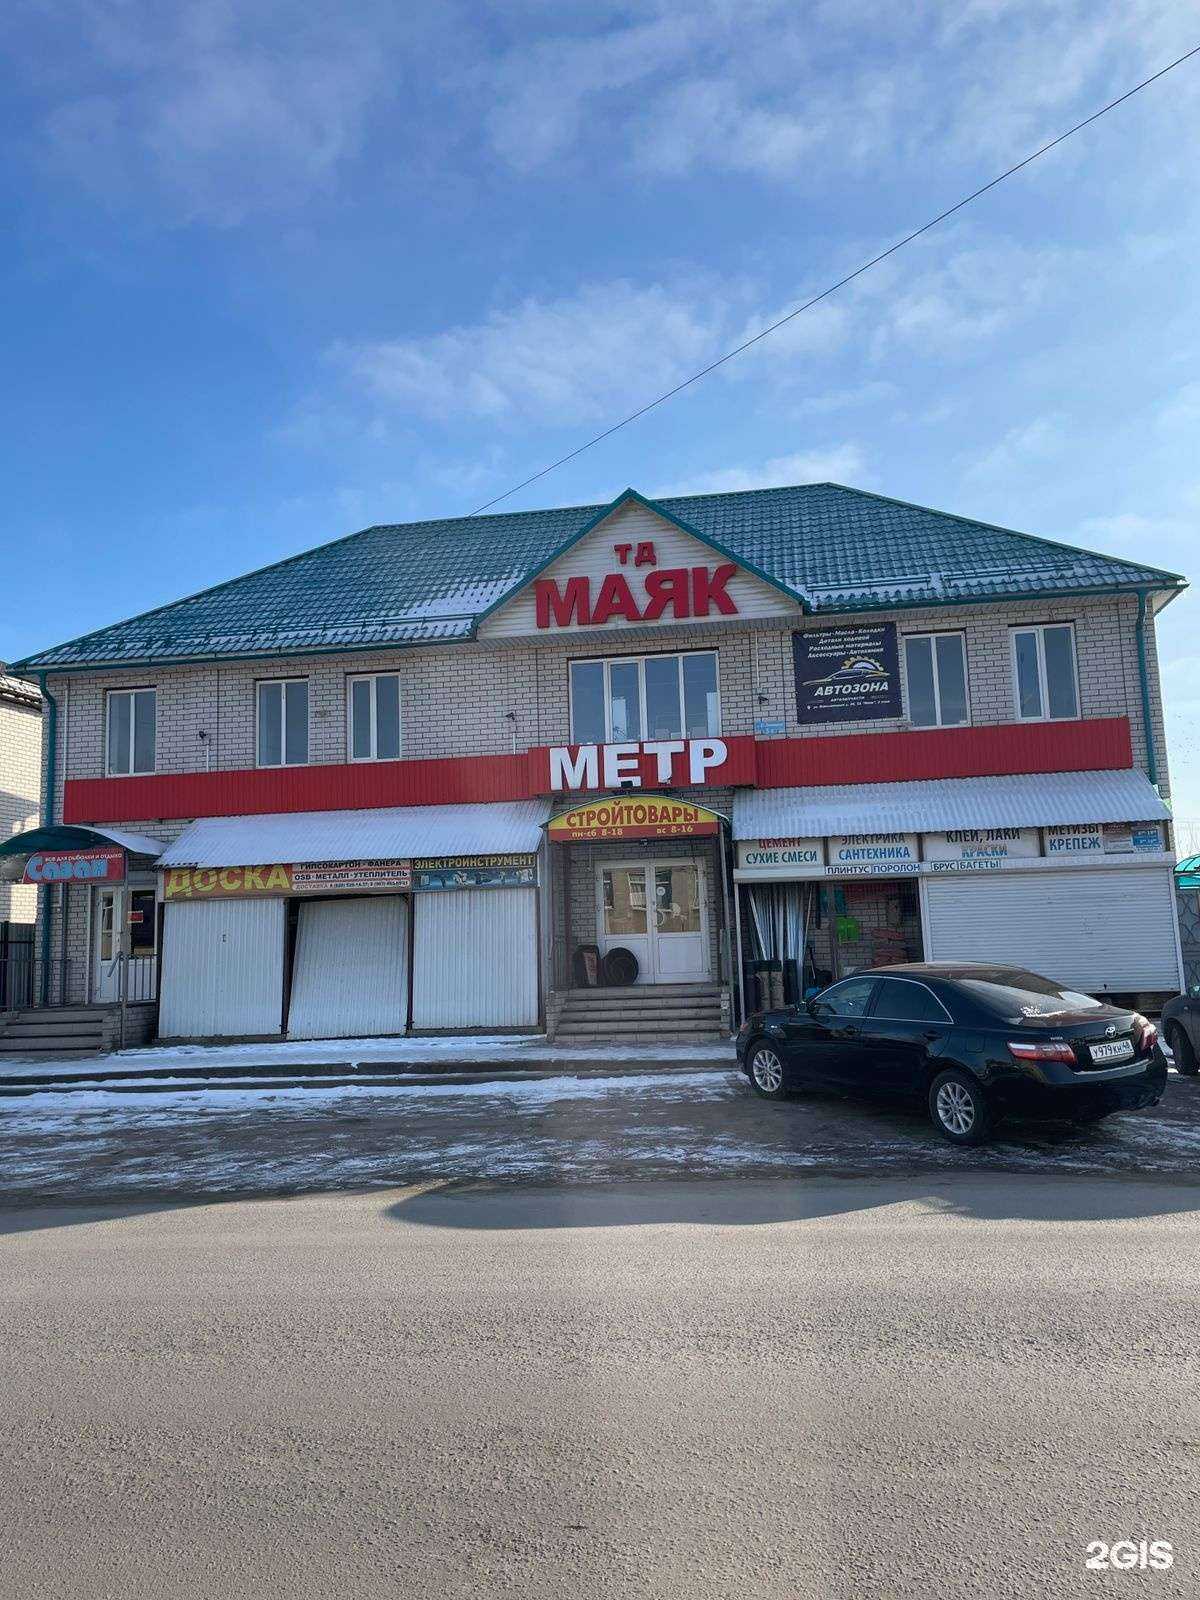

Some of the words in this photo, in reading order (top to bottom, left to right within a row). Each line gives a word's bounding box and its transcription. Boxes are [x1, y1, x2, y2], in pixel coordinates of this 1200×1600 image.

[613, 541, 656, 567] ТД
[534, 564, 739, 629] МАЯК
[813, 681, 889, 697] АВТОЗОНА
[549, 738, 728, 791] МЕТР
[566, 800, 699, 828] СТРОЙТОВАРЫ
[670, 825, 693, 834] 8-16
[986, 828, 1020, 841] ЛАКИ
[841, 833, 905, 846] ЭЛЕКТРИКА
[1049, 837, 1101, 851] КРЕПЕЖ
[746, 852, 779, 865] СУХИЕ
[781, 850, 817, 863] СМЕСИ
[838, 846, 911, 861] САНТЕХНИКА
[300, 861, 361, 870] ГИПСОКАРТОН
[414, 854, 533, 869] ЭЛЕКТРОИНСТРУМЕНТ
[827, 864, 870, 875] ПЛИНТУС
[873, 863, 921, 874] ПОРОЛОН
[933, 862, 956, 871] БРУС
[960, 860, 999, 869] БАГЕТЫ
[165, 865, 291, 898] ДОСКА
[353, 870, 408, 879] УТЕПЛИТЕЛЬ
